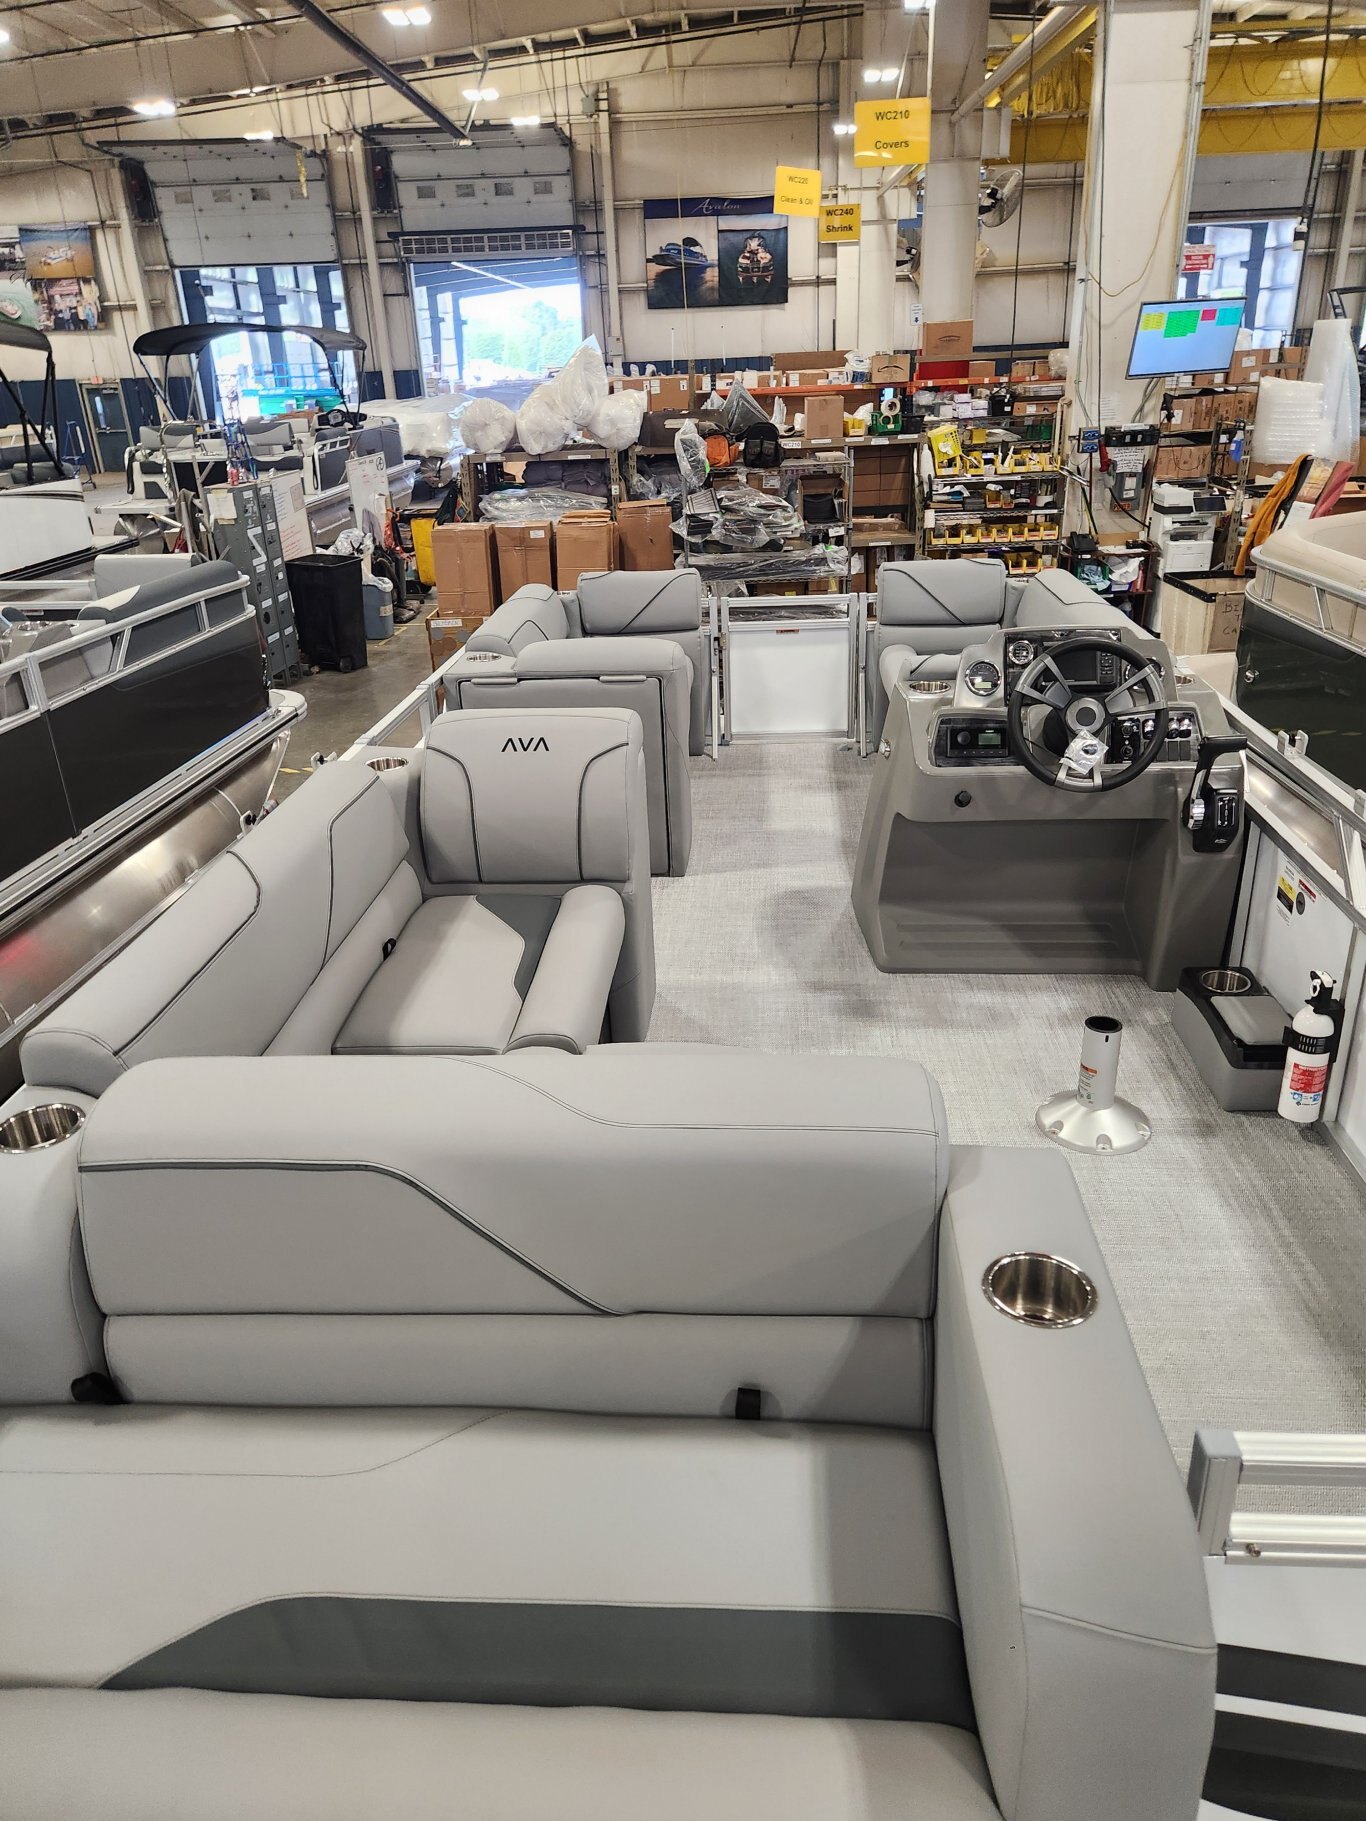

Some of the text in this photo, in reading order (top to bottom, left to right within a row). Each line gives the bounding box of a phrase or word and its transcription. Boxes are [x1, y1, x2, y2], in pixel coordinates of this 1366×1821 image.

[875, 109, 910, 121] WC210
[875, 140, 910, 149] Covers
[780, 195, 797, 204] Clean
[691, 198, 740, 214] Avalon
[825, 207, 854, 217] WC240
[826, 224, 853, 233] Shrink
[501, 736, 550, 753] AVA
